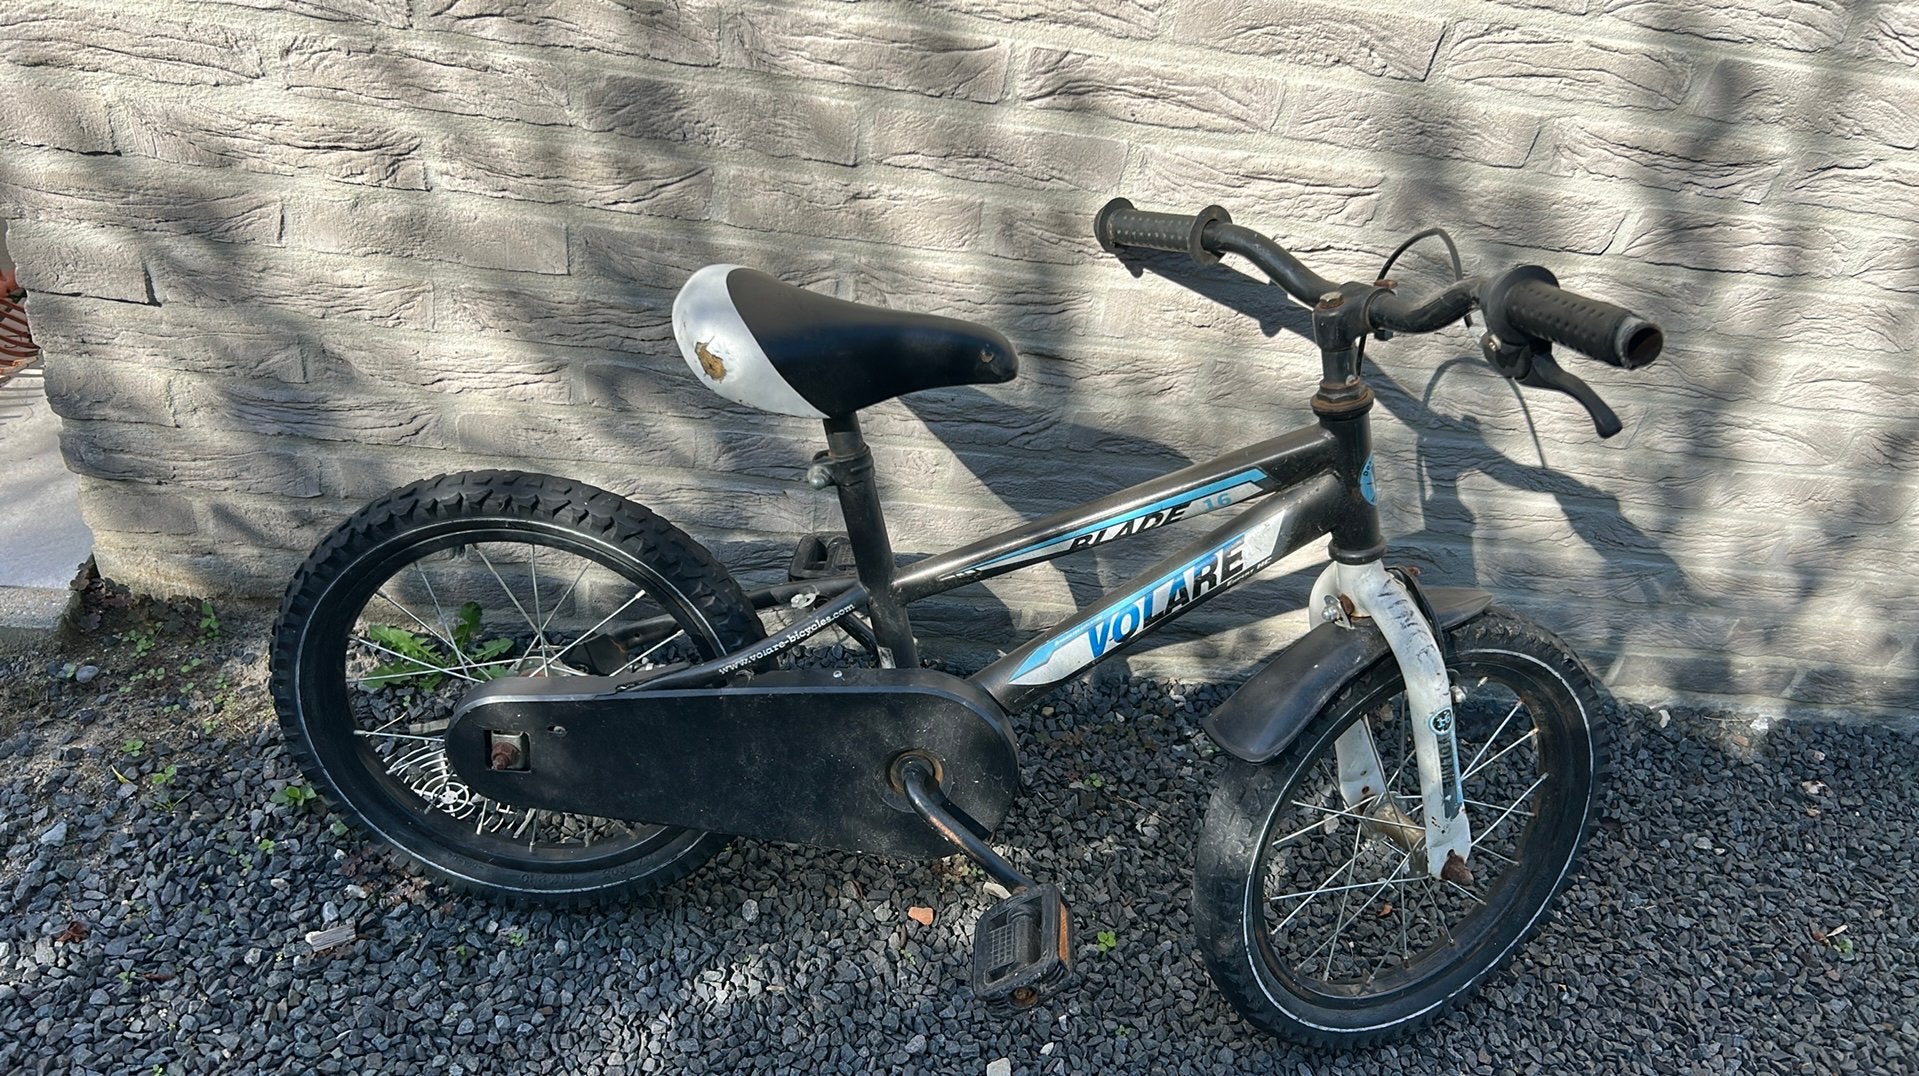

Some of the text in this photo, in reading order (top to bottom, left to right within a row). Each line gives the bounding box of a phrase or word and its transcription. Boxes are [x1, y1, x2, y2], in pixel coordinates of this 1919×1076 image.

[1069, 493, 1231, 550] BLADE 16
[1088, 534, 1245, 658] VOLARE
[718, 602, 856, 675] www.volare-bicycles.com
